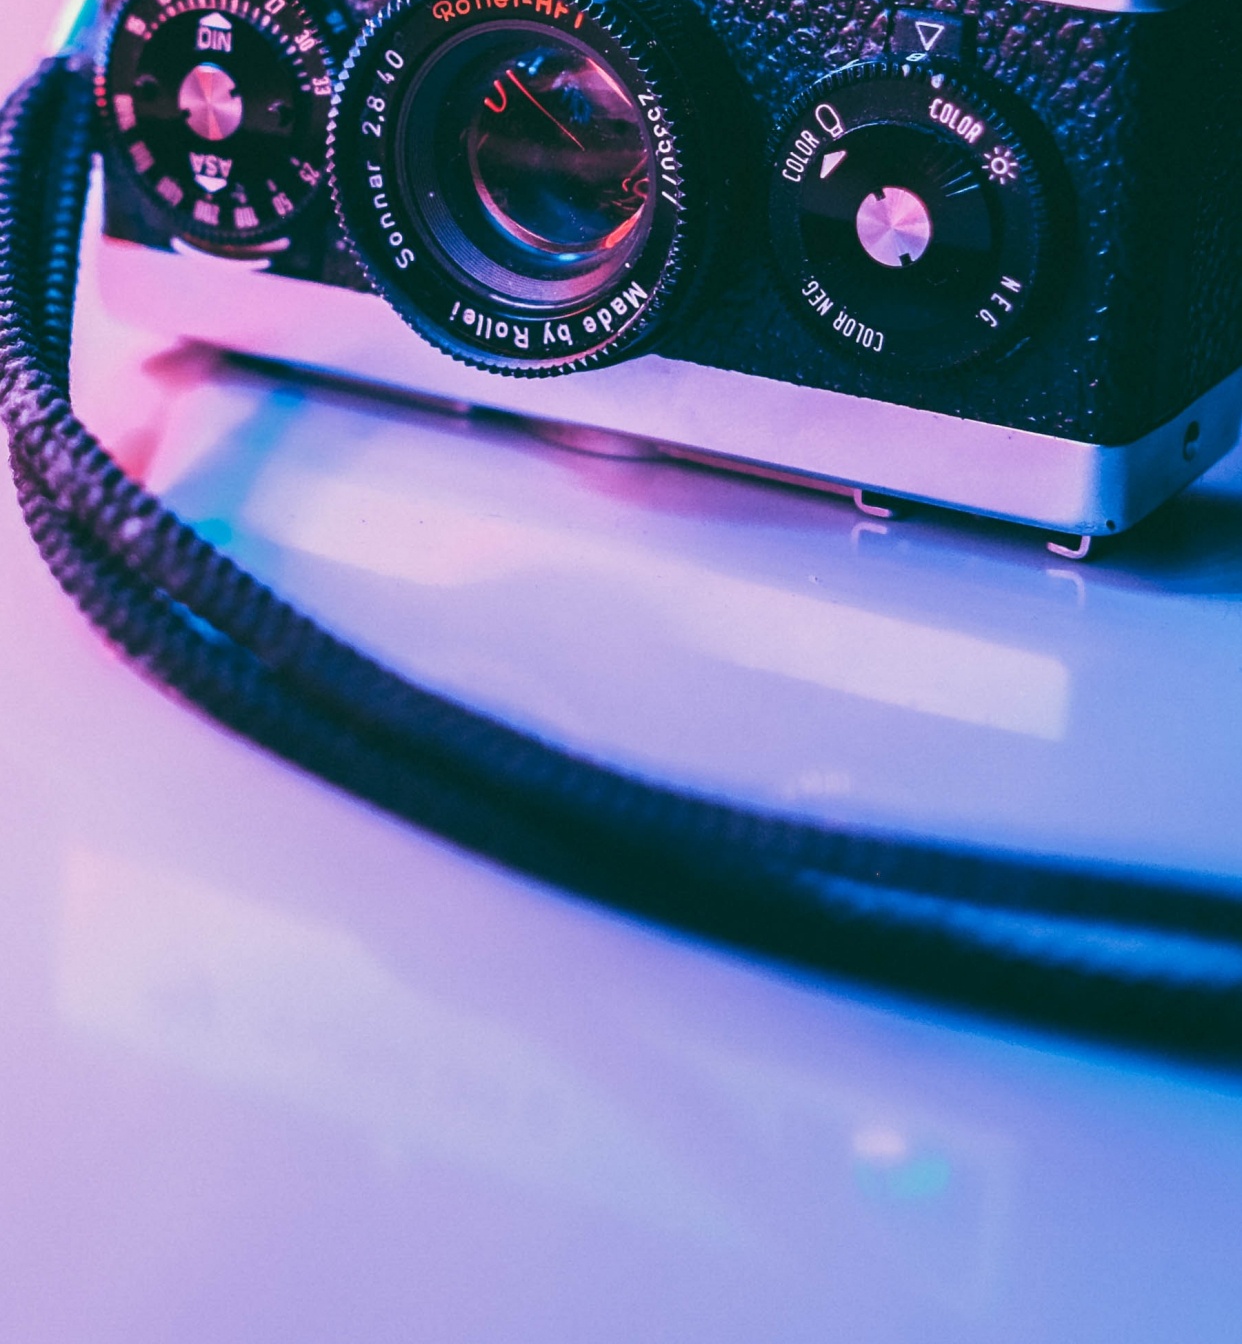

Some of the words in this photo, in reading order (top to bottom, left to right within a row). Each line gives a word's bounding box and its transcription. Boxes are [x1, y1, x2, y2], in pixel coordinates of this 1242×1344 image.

[196, 27, 233, 53] DIN
[295, 28, 316, 52] 30
[929, 97, 985, 144] COLOR
[189, 152, 232, 177] ASA
[783, 129, 820, 183] COLOR
[367, 161, 415, 269] Sonnar
[449, 301, 530, 349] Rollei
[583, 280, 650, 333] Made
[541, 321, 573, 347] by
[832, 310, 885, 353] COLOR
